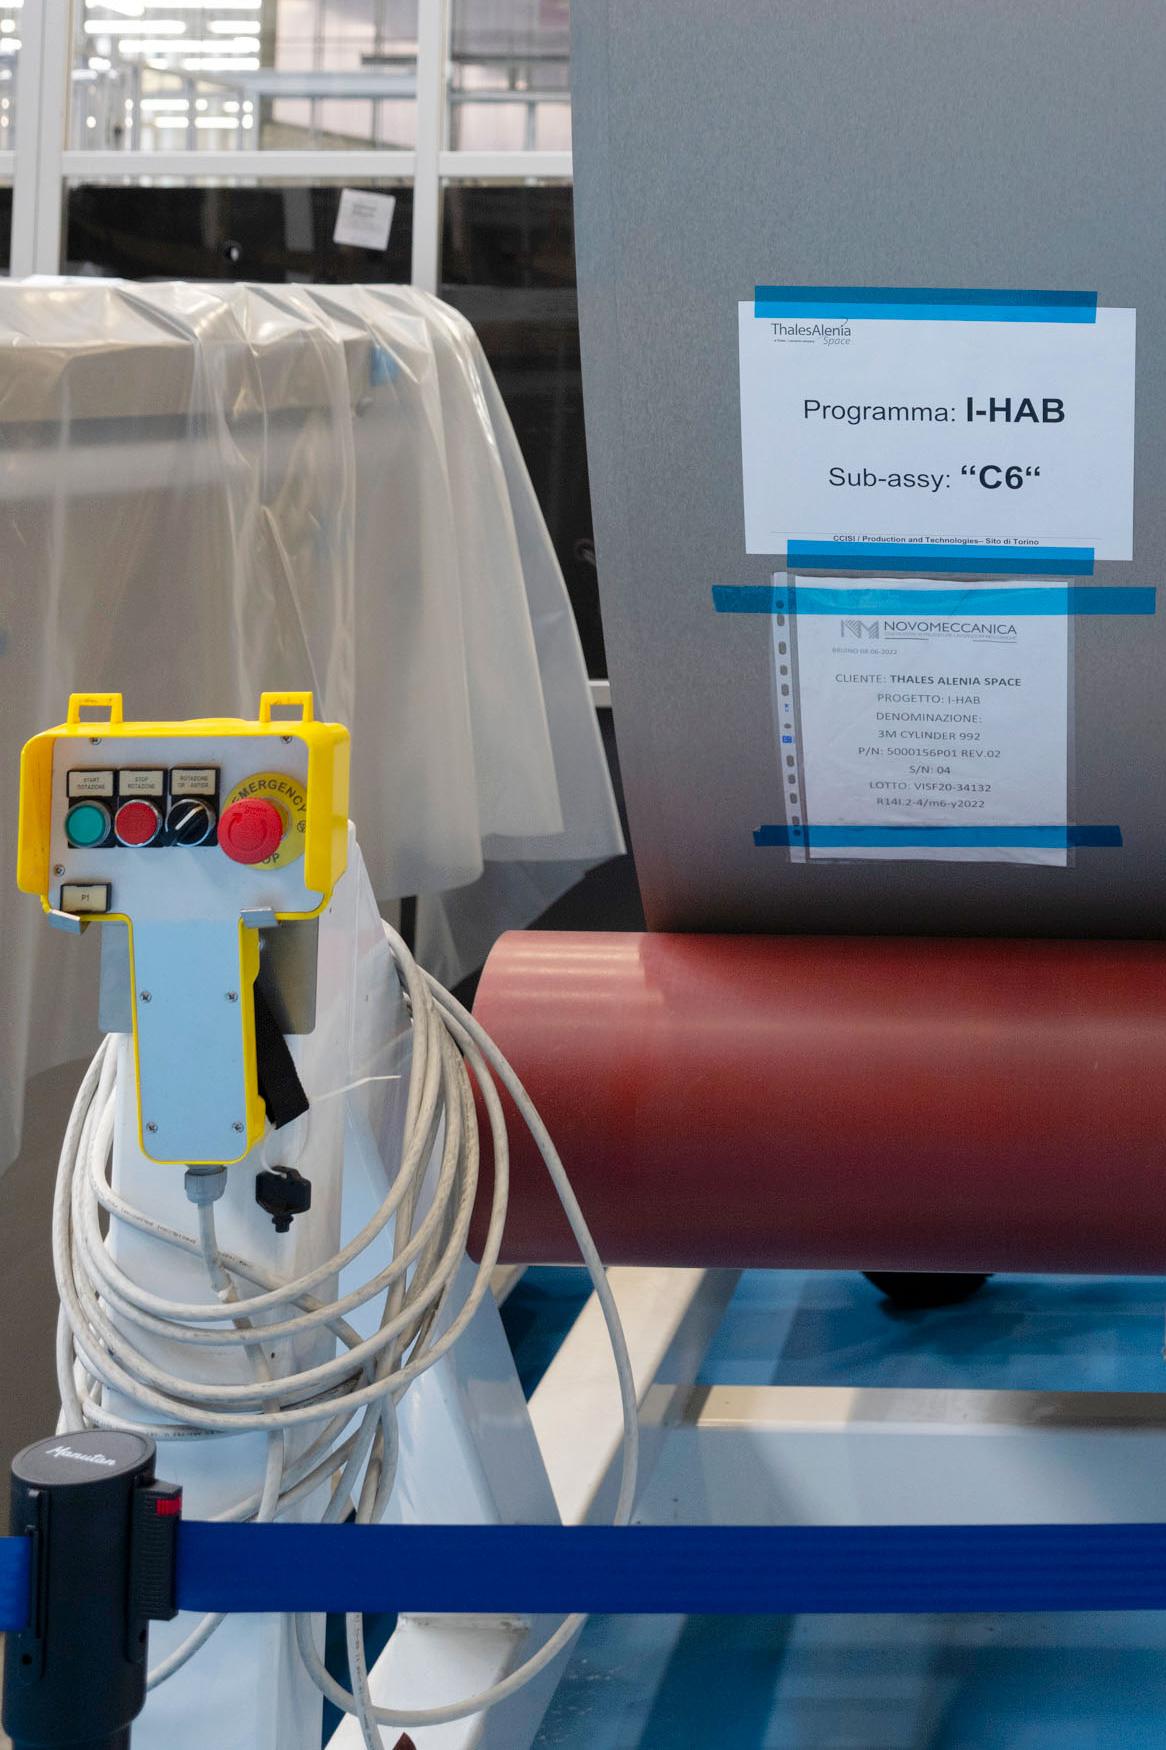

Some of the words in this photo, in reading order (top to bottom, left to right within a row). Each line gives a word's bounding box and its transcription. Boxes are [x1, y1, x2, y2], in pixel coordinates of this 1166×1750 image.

[771, 321, 852, 337] ThalesAlenia
[823, 336, 852, 346] Space
[803, 399, 956, 425] Programma:
[966, 397, 1066, 423] I-HAB
[829, 467, 951, 493] Sub-assy:
[862, 535, 906, 544] Production
[908, 536, 923, 544] and
[1003, 538, 1012, 546] di
[1014, 538, 1040, 546] Torino
[884, 620, 1018, 636] NOVOMECCANICA
[835, 673, 887, 684] CLIENTE:
[890, 674, 935, 685] THALES
[937, 676, 981, 686] ALENIA
[983, 677, 1022, 687] SPACE
[877, 693, 945, 705] PROGETTO:
[947, 695, 981, 705] I-HAB
[876, 712, 982, 723] DENOMINAZIONE:
[878, 730, 897, 739] 3M
[900, 730, 957, 740] CYLINDER
[959, 732, 981, 741] 992
[858, 746, 883, 756] P/N:
[887, 747, 957, 758] 5000156P01
[961, 749, 1001, 759] REV.02
[909, 765, 934, 775] S/N:
[936, 766, 951, 775] 04
[869, 781, 911, 791] LOTTO:
[81, 893, 90, 902] P1
[46, 1445, 116, 1466] Manutan
